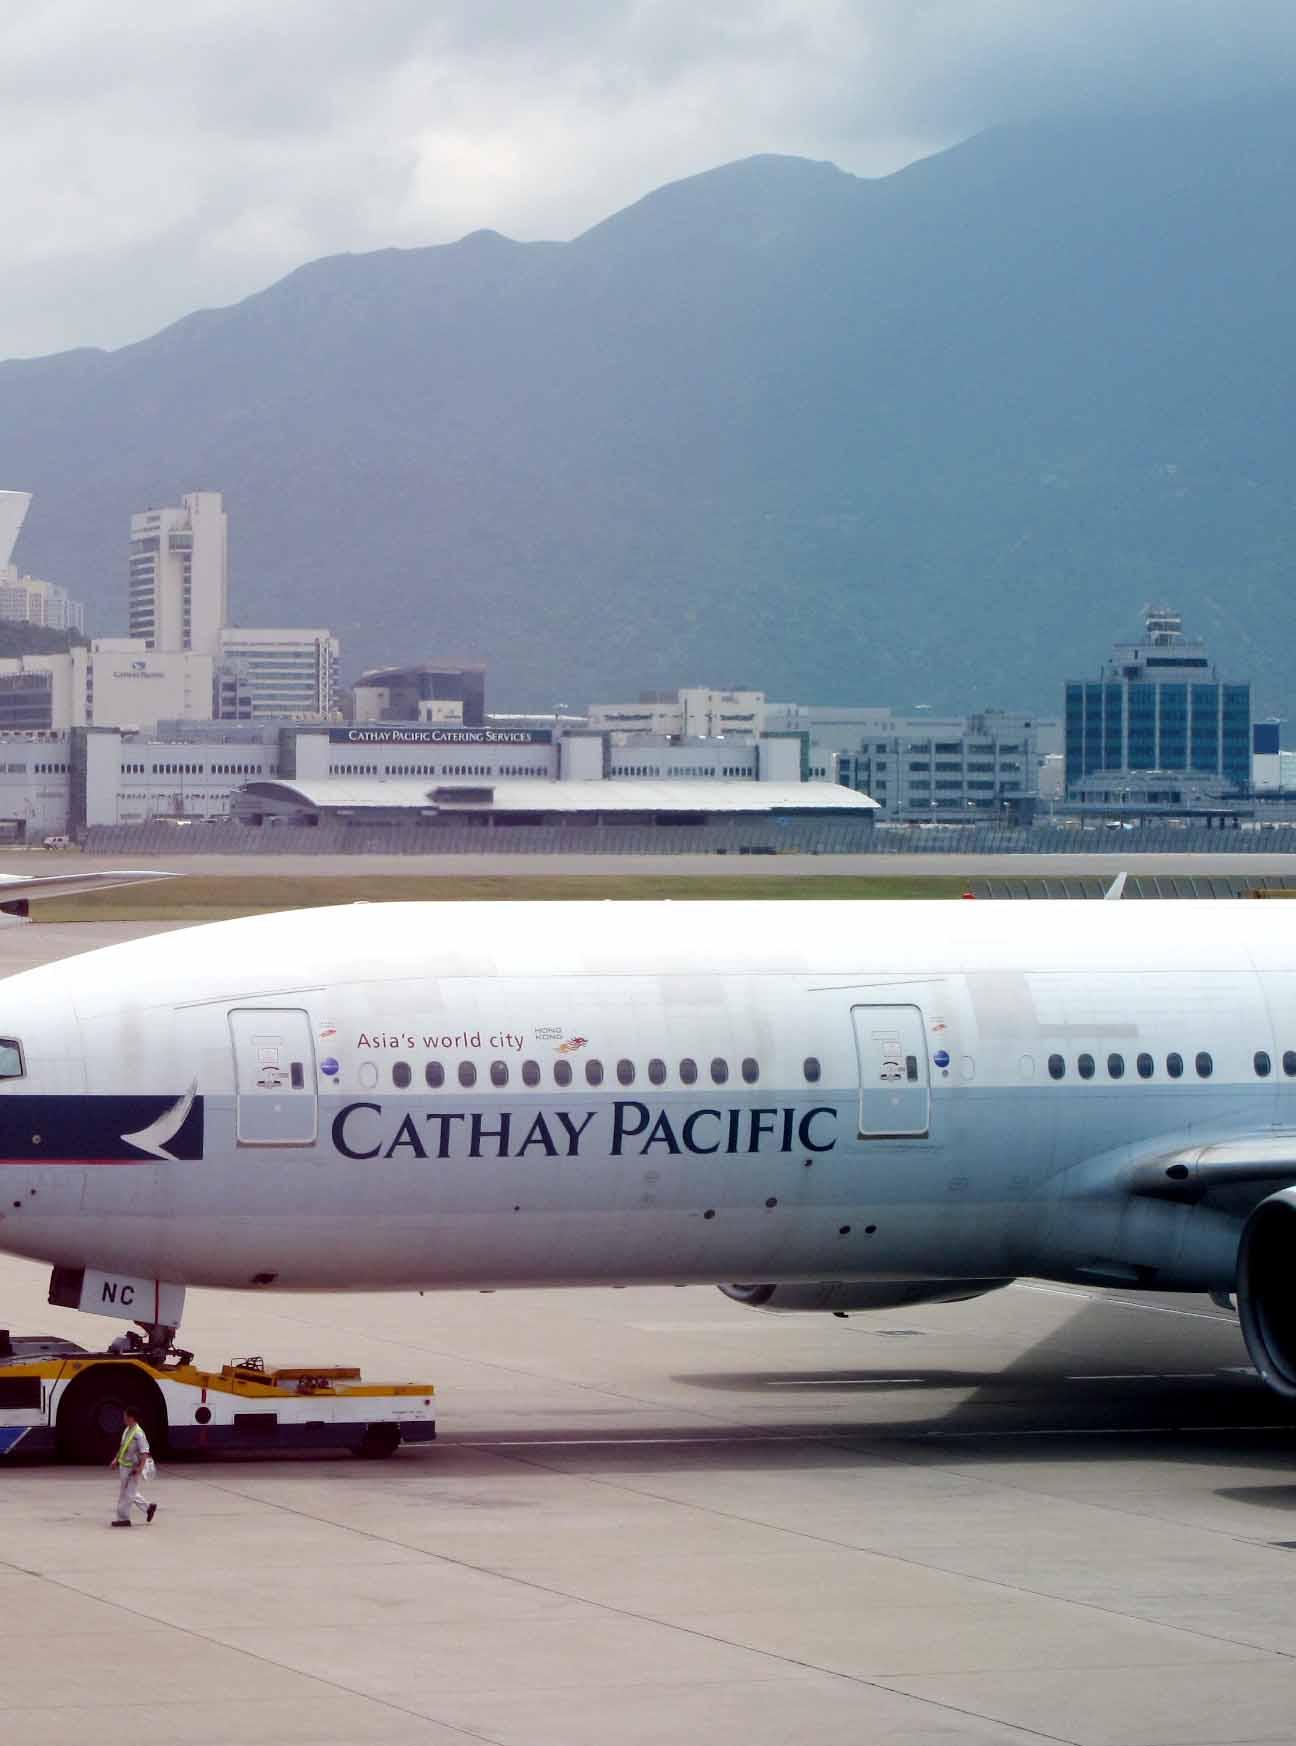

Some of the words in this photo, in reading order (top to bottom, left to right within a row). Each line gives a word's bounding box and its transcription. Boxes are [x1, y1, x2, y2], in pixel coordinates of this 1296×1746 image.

[348, 730, 390, 741] CATHAY
[392, 730, 430, 741] PACIFIC
[432, 730, 484, 741] CATERING
[486, 730, 531, 741] SERVICES
[357, 1032, 415, 1048] Asia's
[423, 1032, 481, 1048] world
[490, 1032, 524, 1051] city
[331, 1102, 599, 1160] CATHAY
[608, 1101, 839, 1156] PACIFIC
[101, 1281, 135, 1305] NC
